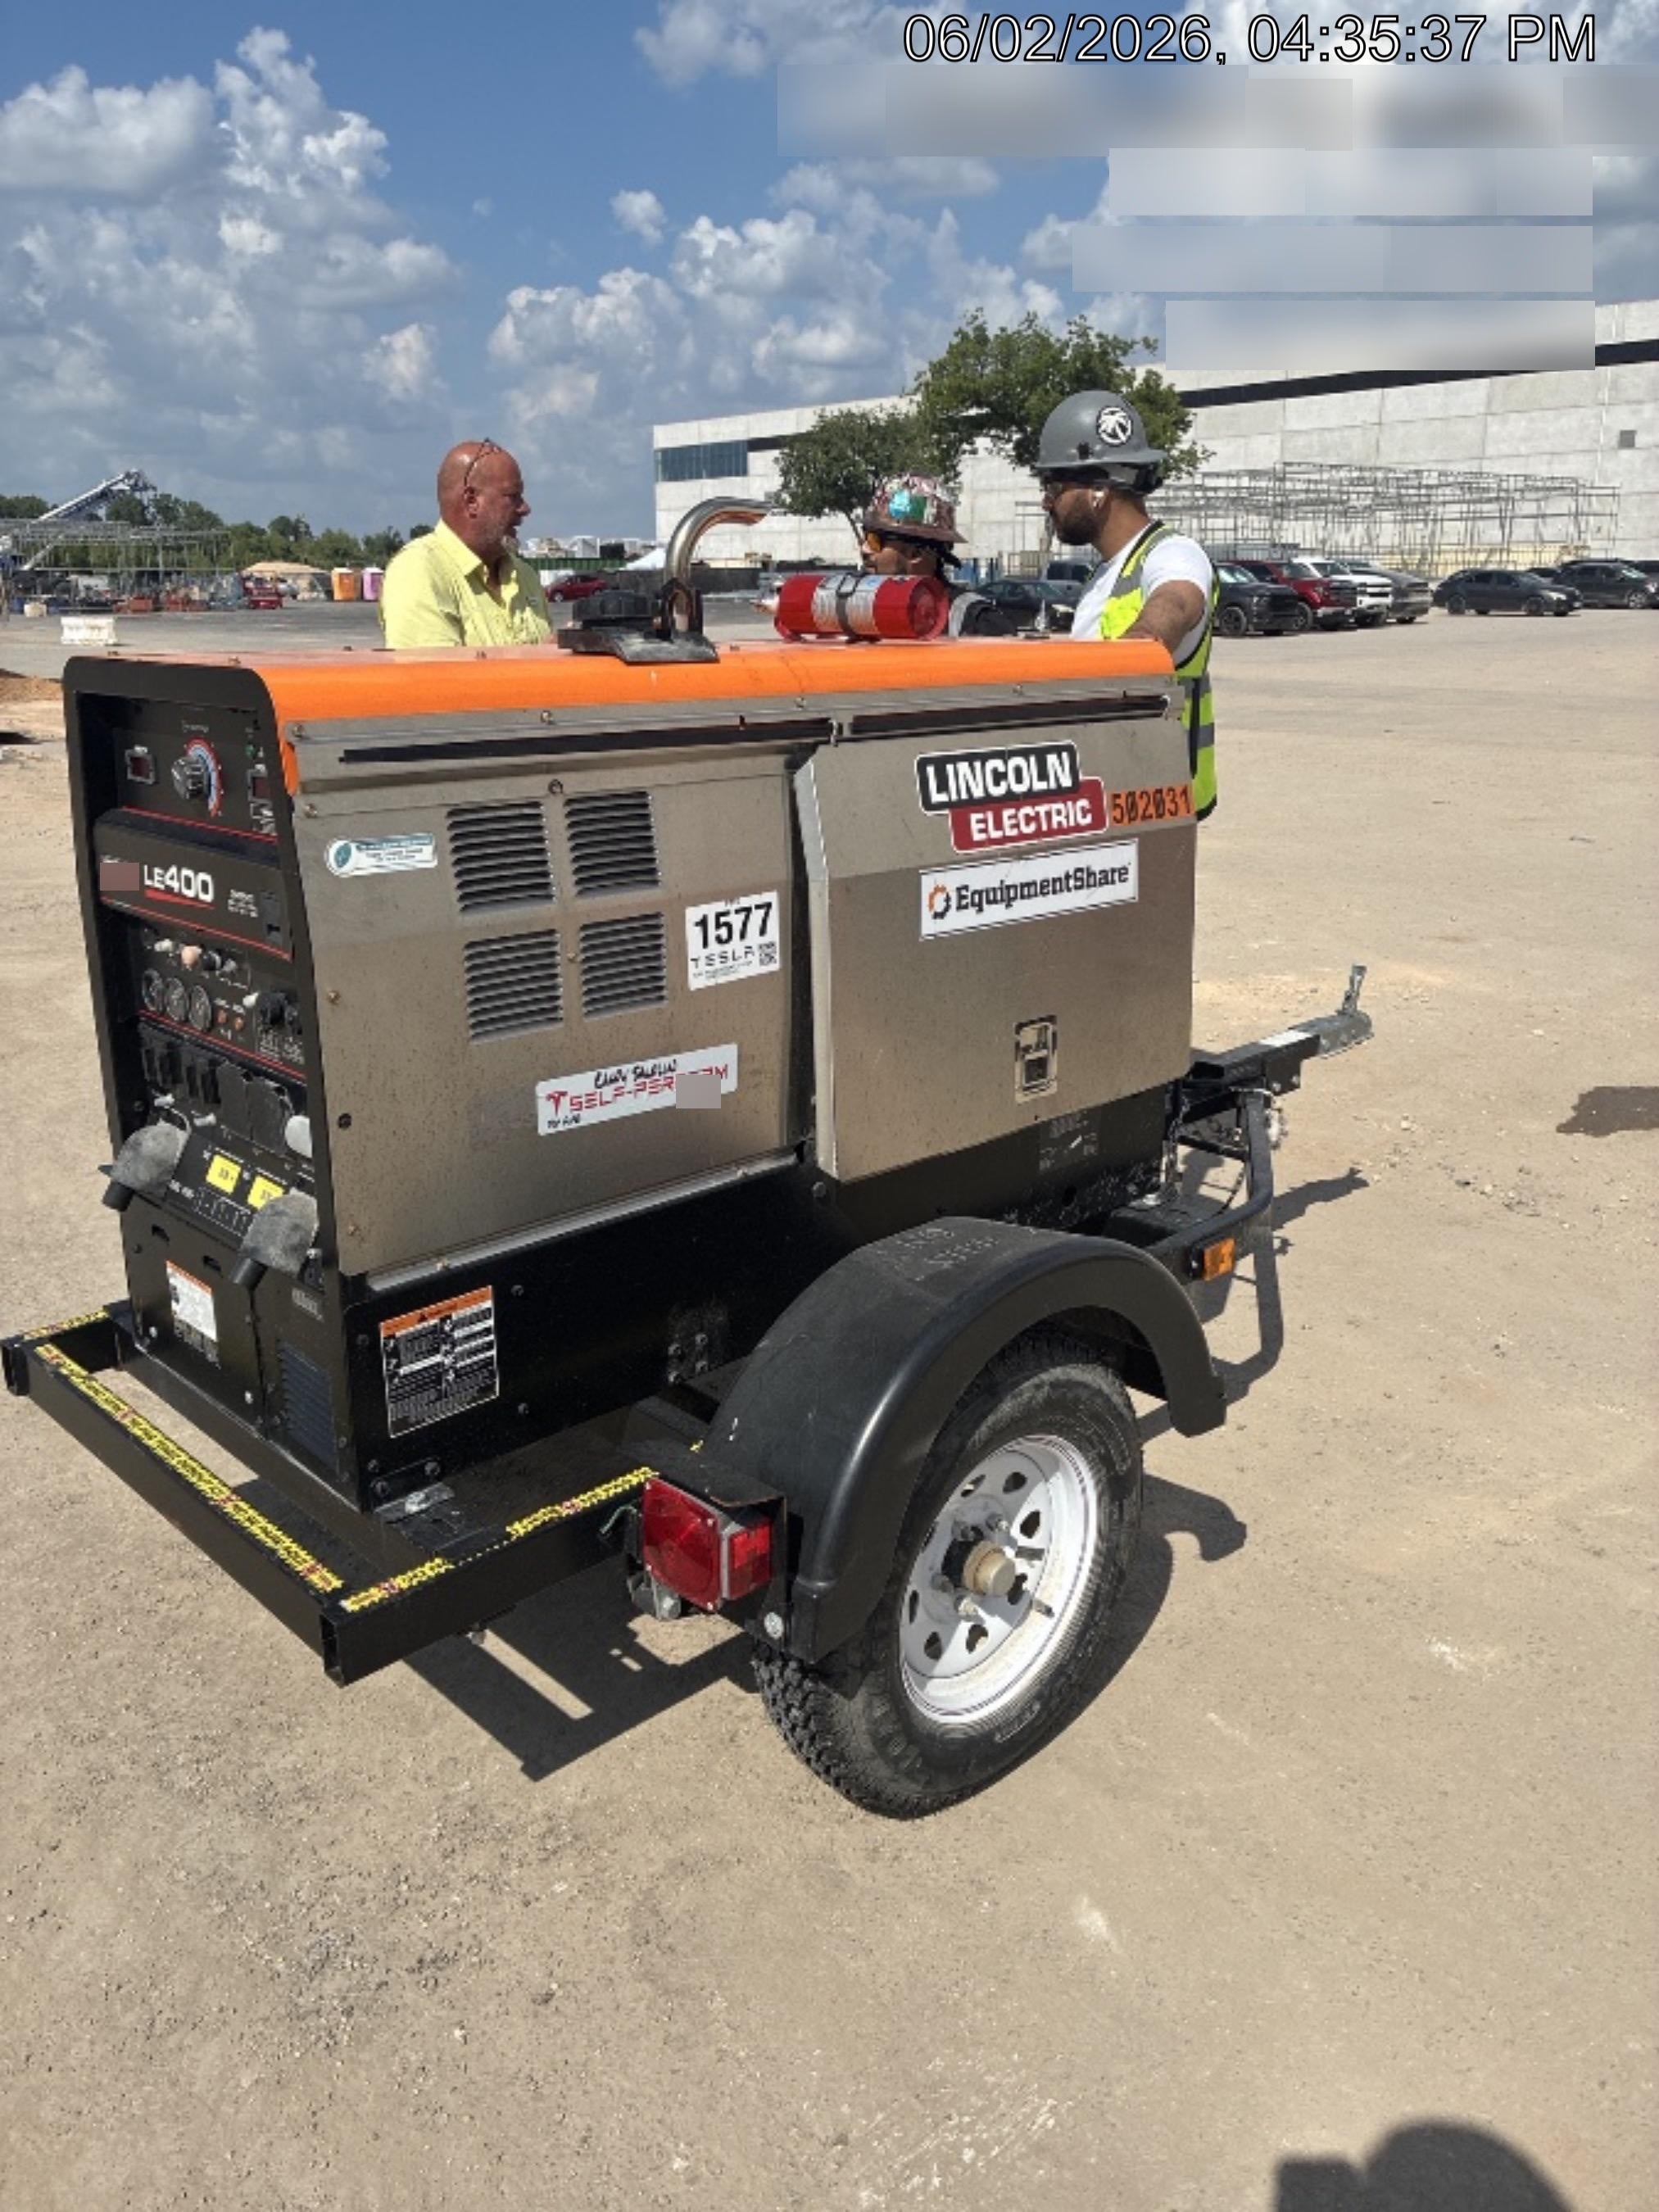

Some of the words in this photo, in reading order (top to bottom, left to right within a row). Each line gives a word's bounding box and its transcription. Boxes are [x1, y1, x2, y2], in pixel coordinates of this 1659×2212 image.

[926, 751, 1072, 804] LINCOLN
[970, 798, 1092, 841] ELECTRIC
[1112, 786, 1191, 824] 502031
[143, 864, 215, 904] LE400
[955, 863, 1129, 913] EquipmentShare
[694, 901, 773, 950] 1577
[690, 945, 755, 969] TESLA
